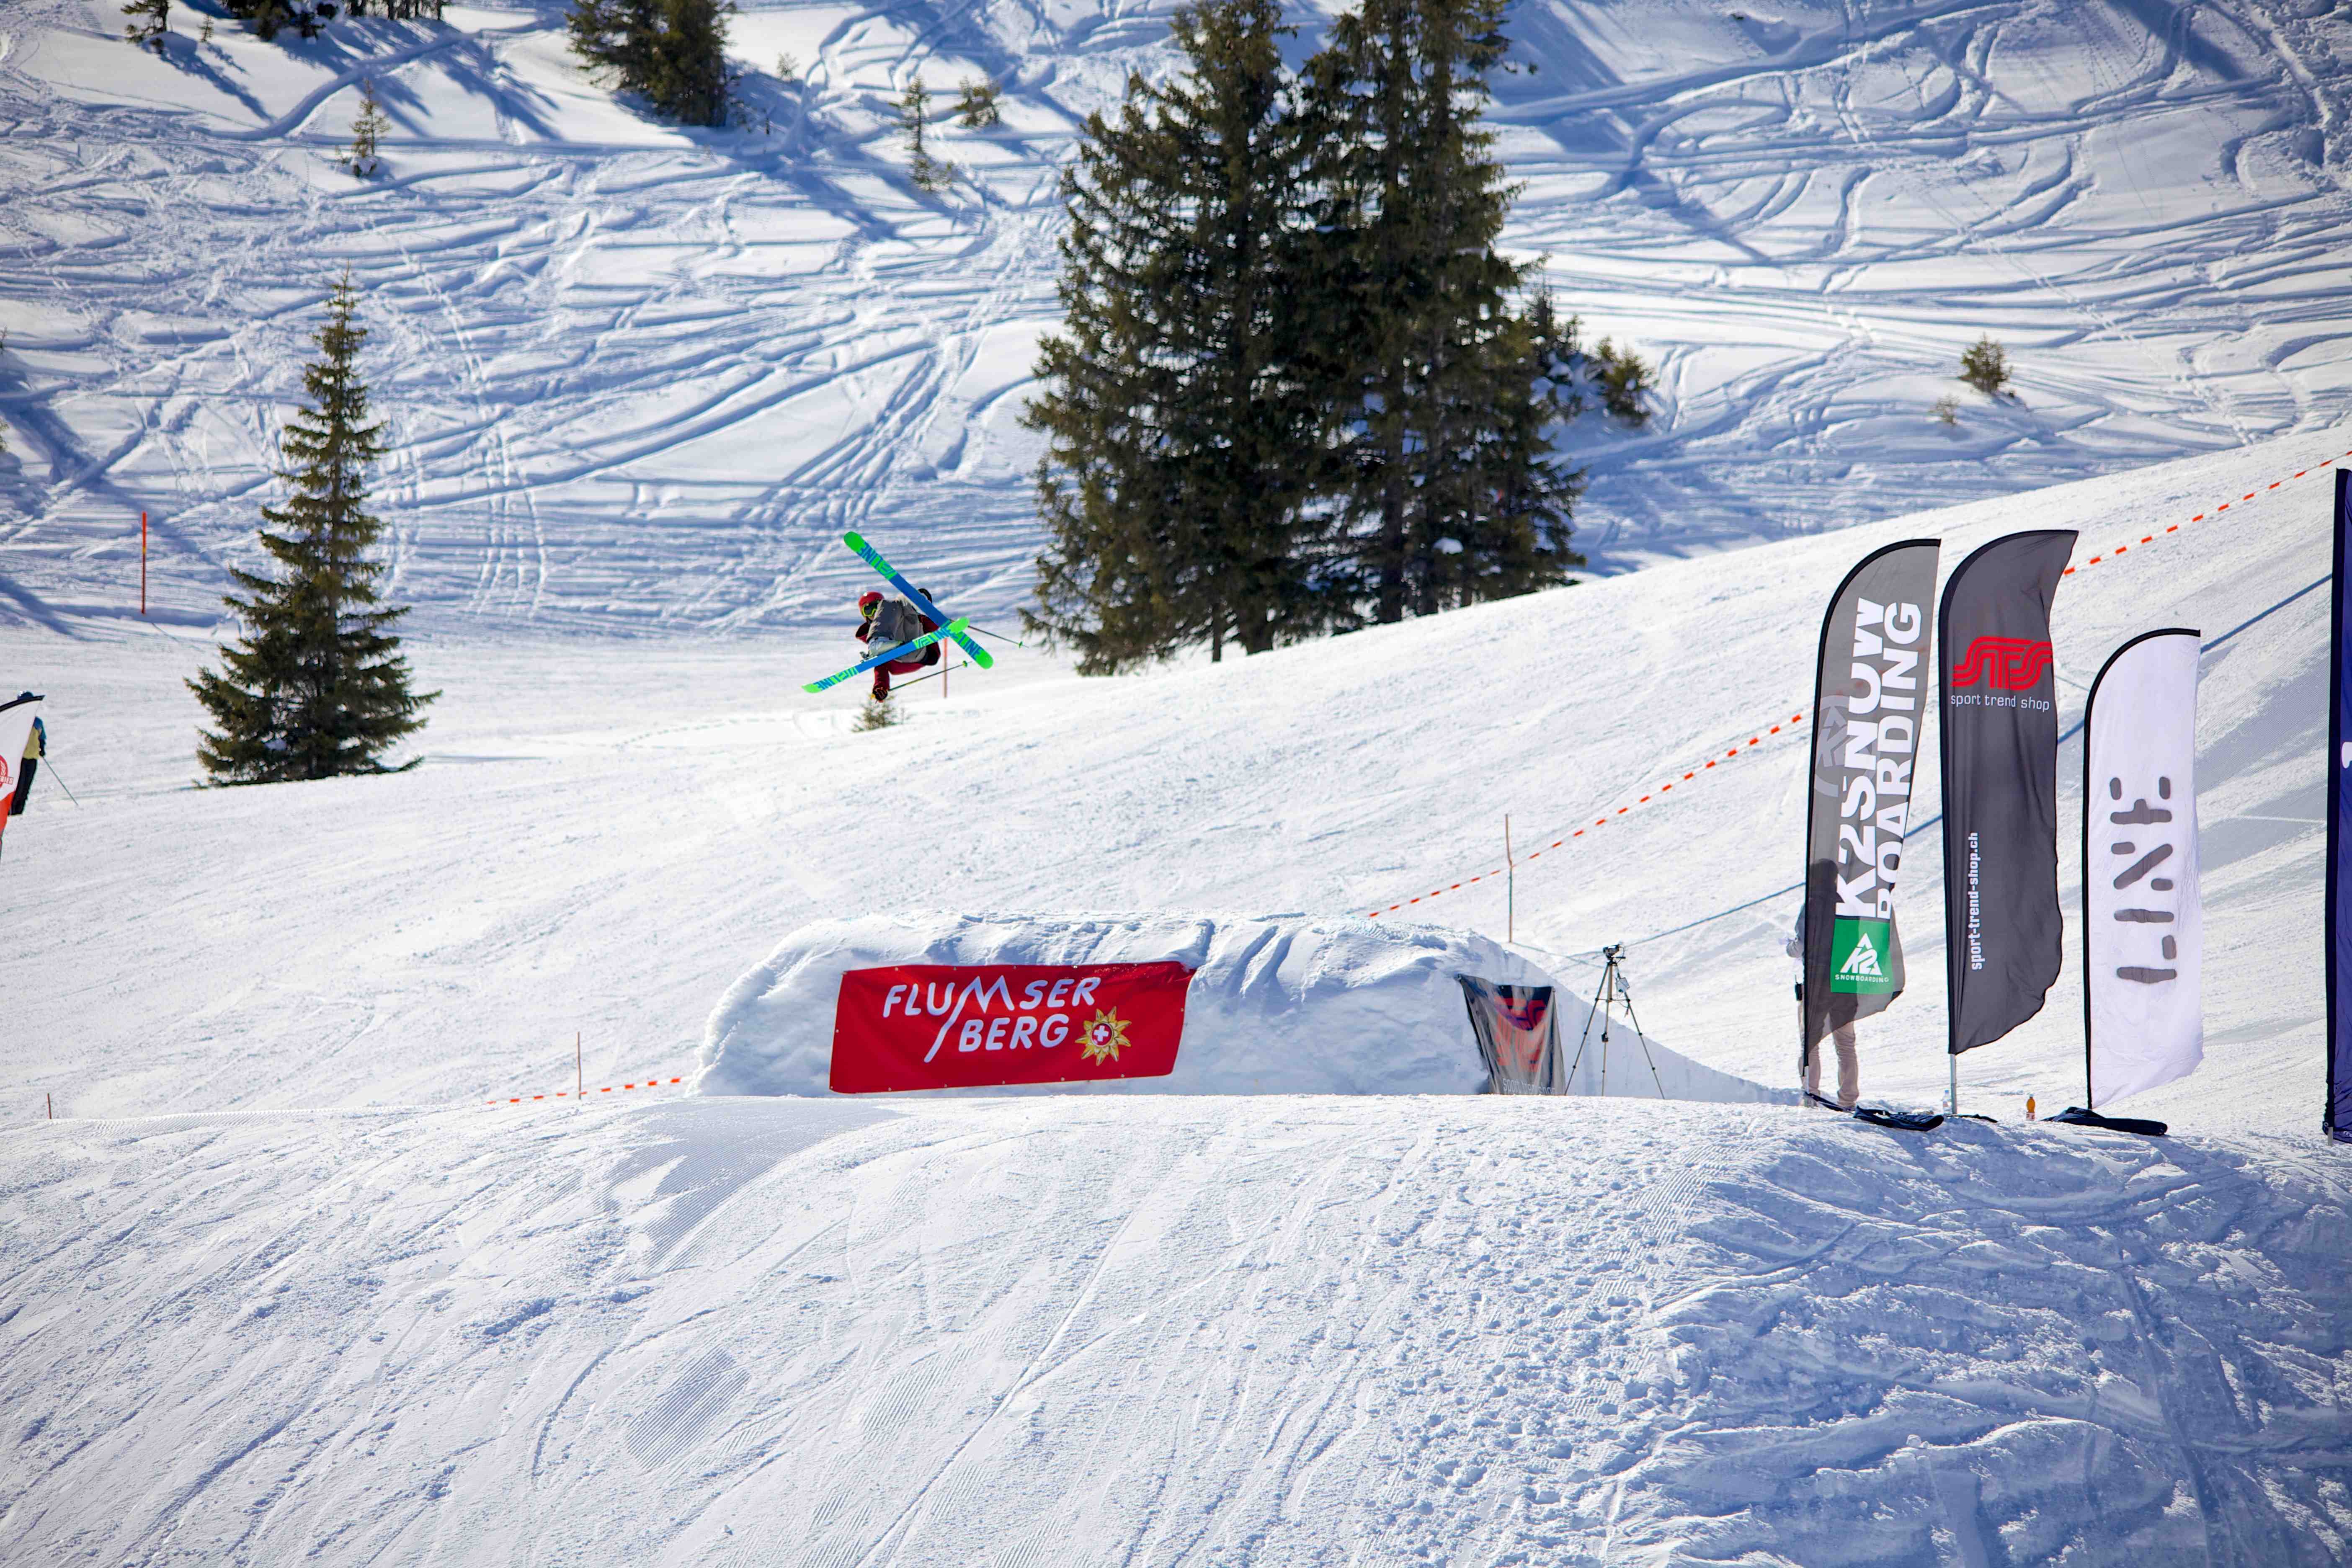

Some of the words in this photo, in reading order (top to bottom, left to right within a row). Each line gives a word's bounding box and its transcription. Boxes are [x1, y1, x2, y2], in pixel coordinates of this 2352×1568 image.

[1950, 636, 2053, 691] STS
[1951, 694, 1981, 707] sport
[1984, 695, 2016, 707] trend
[2021, 697, 2050, 712] shop
[1968, 832, 1984, 970] sport-trend-shop.ch
[2110, 776, 2177, 984] LINE
[1835, 974, 1890, 983] SNOWBOARDING
[1840, 932, 1883, 976] K2
[883, 975, 1101, 1063] FLUMSER
[958, 1014, 1070, 1052] BERG
